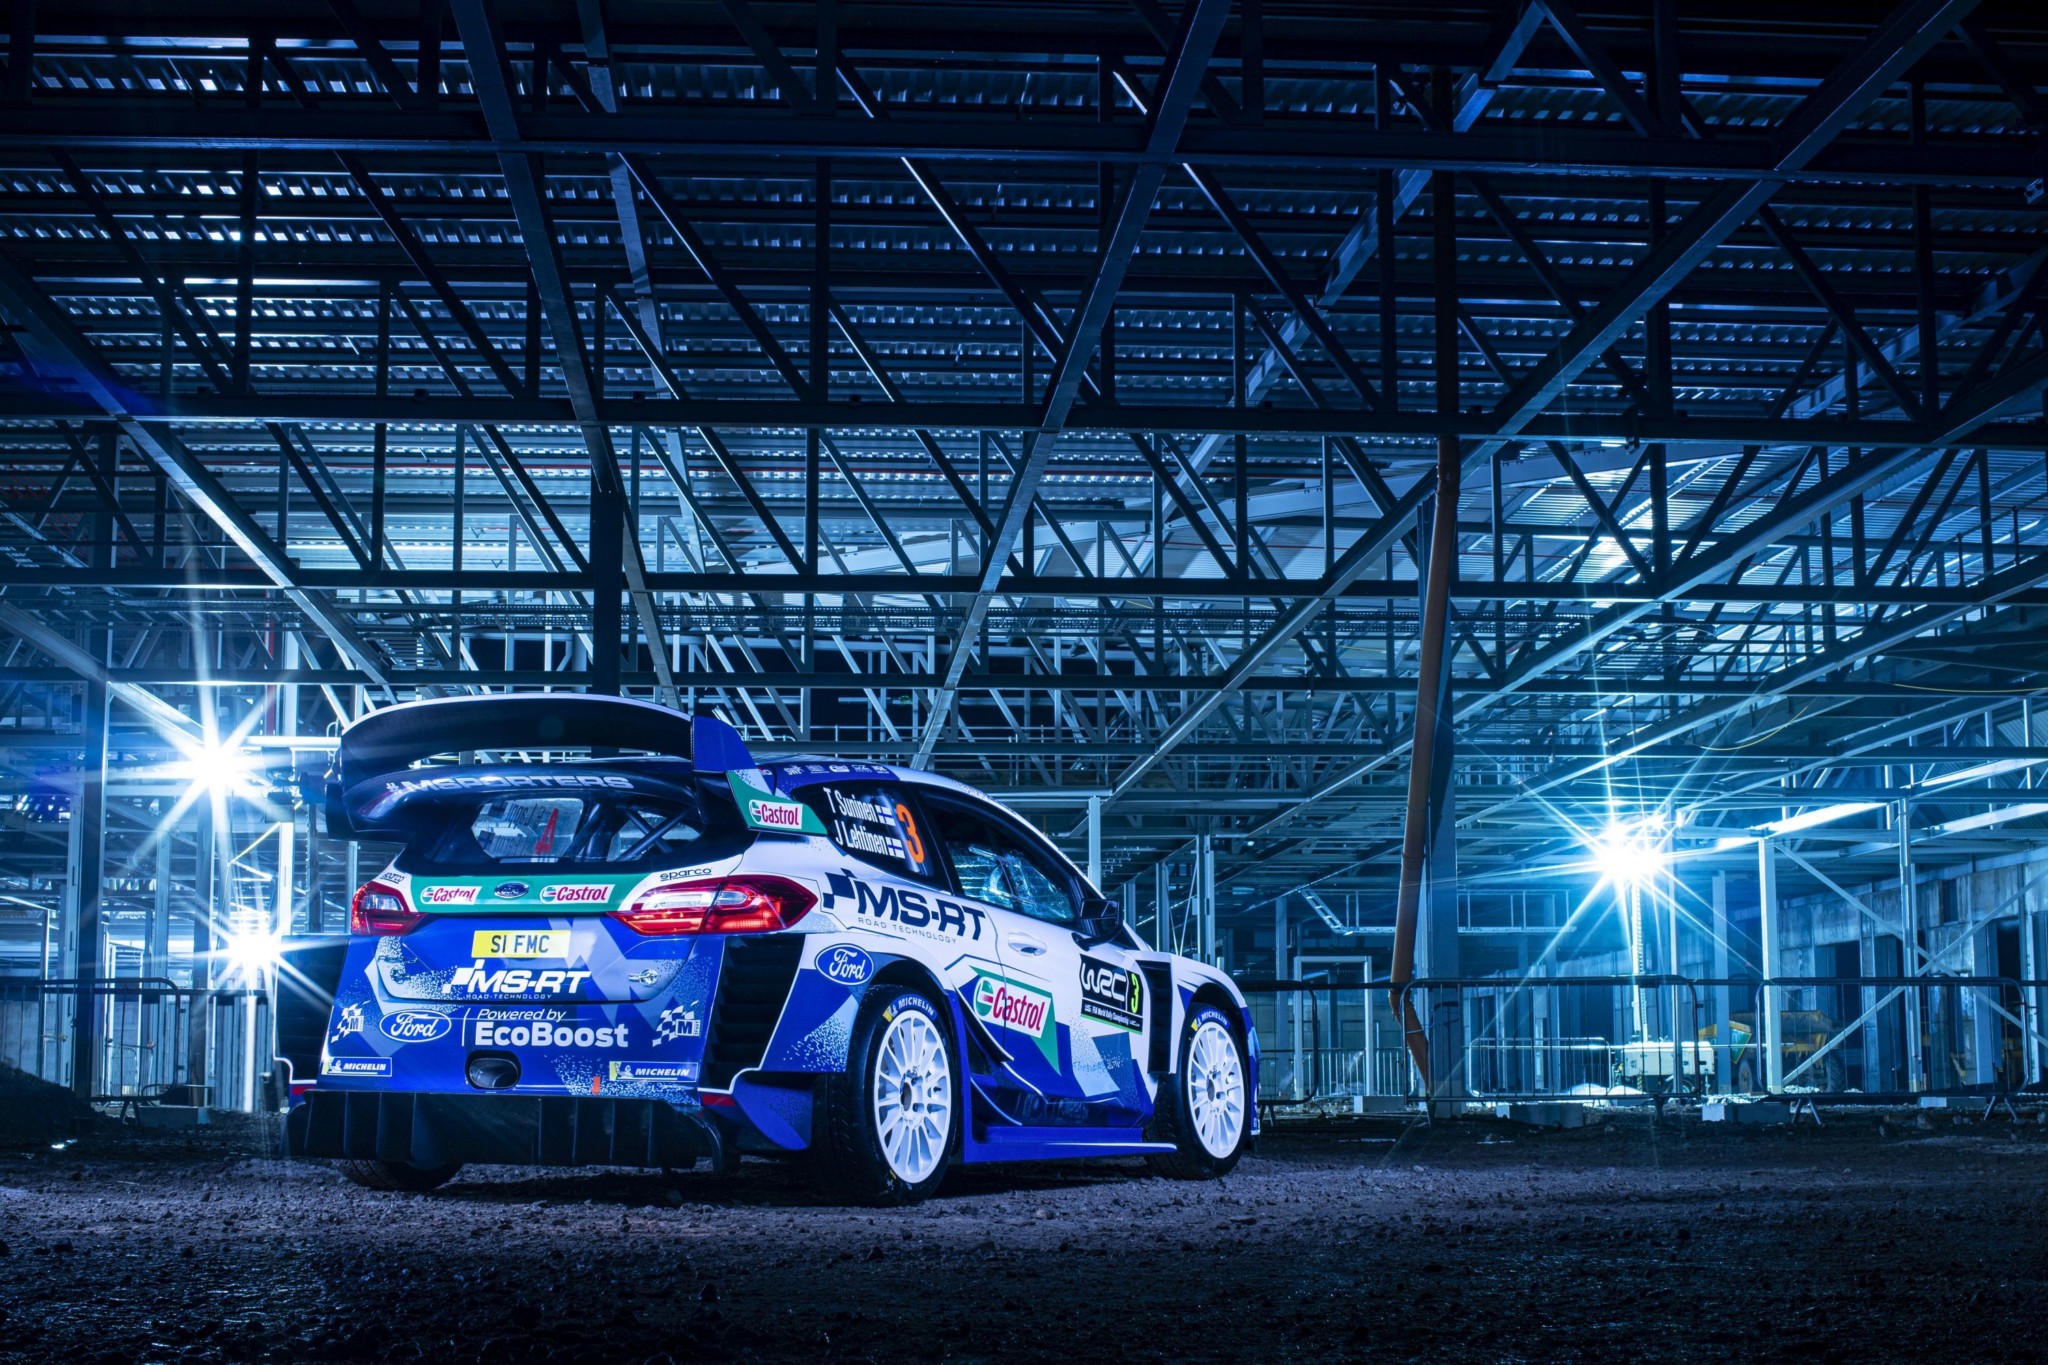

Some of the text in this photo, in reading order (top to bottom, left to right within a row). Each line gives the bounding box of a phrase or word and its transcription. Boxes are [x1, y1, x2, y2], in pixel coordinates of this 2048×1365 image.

[385, 775, 635, 793] #MSPORTERS
[760, 803, 800, 826] Castrol
[823, 787, 879, 823] T Suninen
[834, 819, 889, 856] J Lehtinen
[896, 803, 925, 864] 3
[433, 887, 476, 903] Castrol
[556, 886, 610, 902] Castrol
[852, 879, 987, 941] MS-RT
[857, 917, 957, 945] ROAD TECHNOLOGY
[514, 935, 550, 953] FMC
[829, 948, 866, 980] Ford
[467, 970, 592, 993] MS-RT
[1081, 963, 1140, 1014] WRC 3
[477, 1008, 567, 1023] Powered by
[898, 996, 935, 1016] MICHELIN
[993, 987, 1046, 1032] Castrol
[390, 1012, 439, 1037] Ford
[474, 1021, 629, 1048] EcoBoost
[677, 1020, 694, 1035] M
[343, 1062, 387, 1071] MICHELIN
[635, 1068, 690, 1077] MICHELIN
